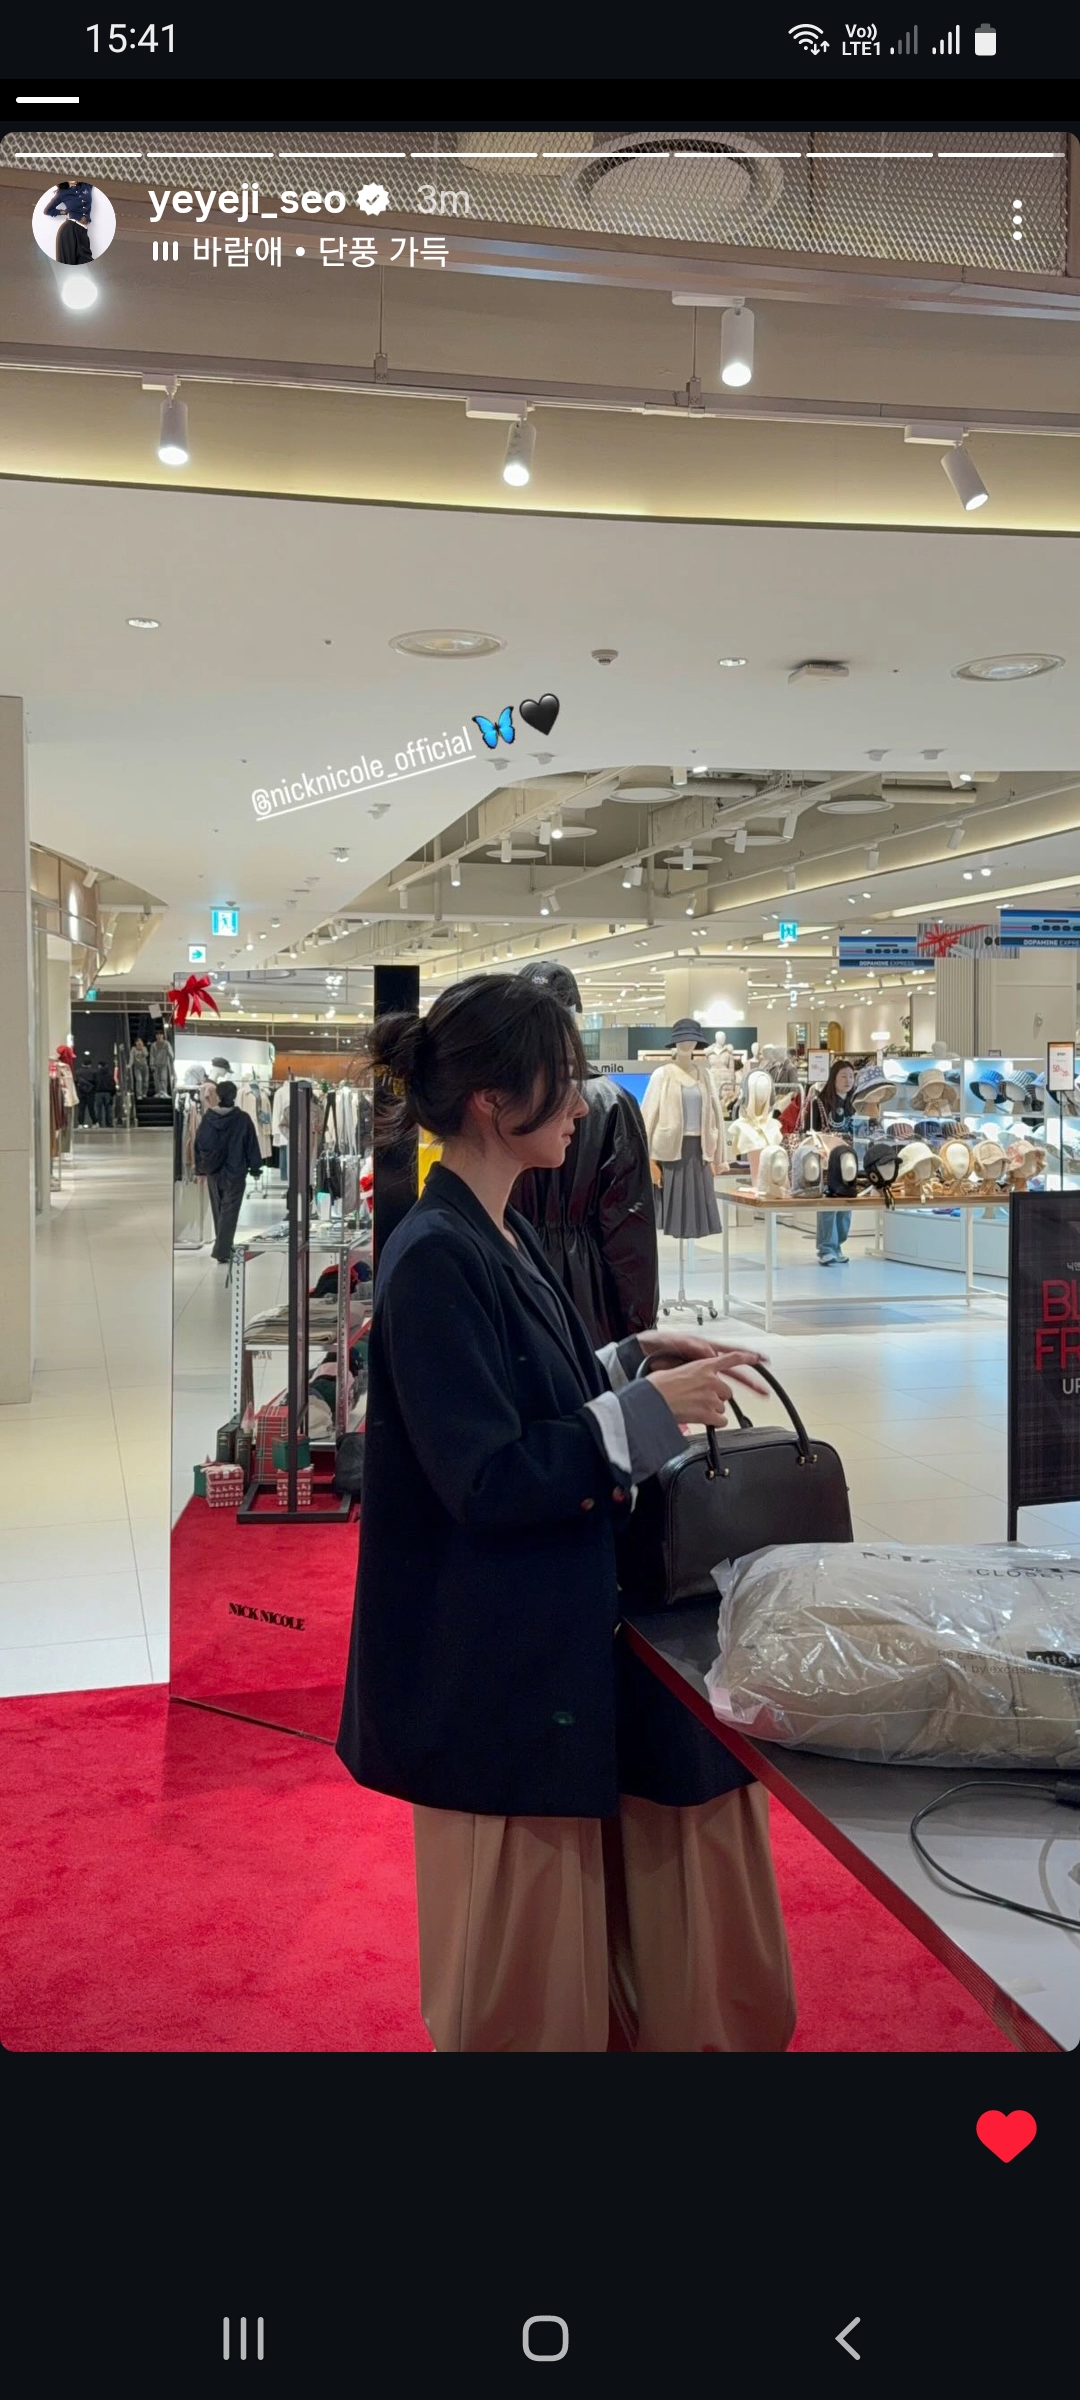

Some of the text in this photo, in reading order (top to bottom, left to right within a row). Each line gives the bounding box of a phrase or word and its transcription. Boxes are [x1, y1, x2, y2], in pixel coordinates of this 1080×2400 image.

[601, 1063, 624, 1073] mila
[228, 1602, 306, 1632] NICK NICOLE
